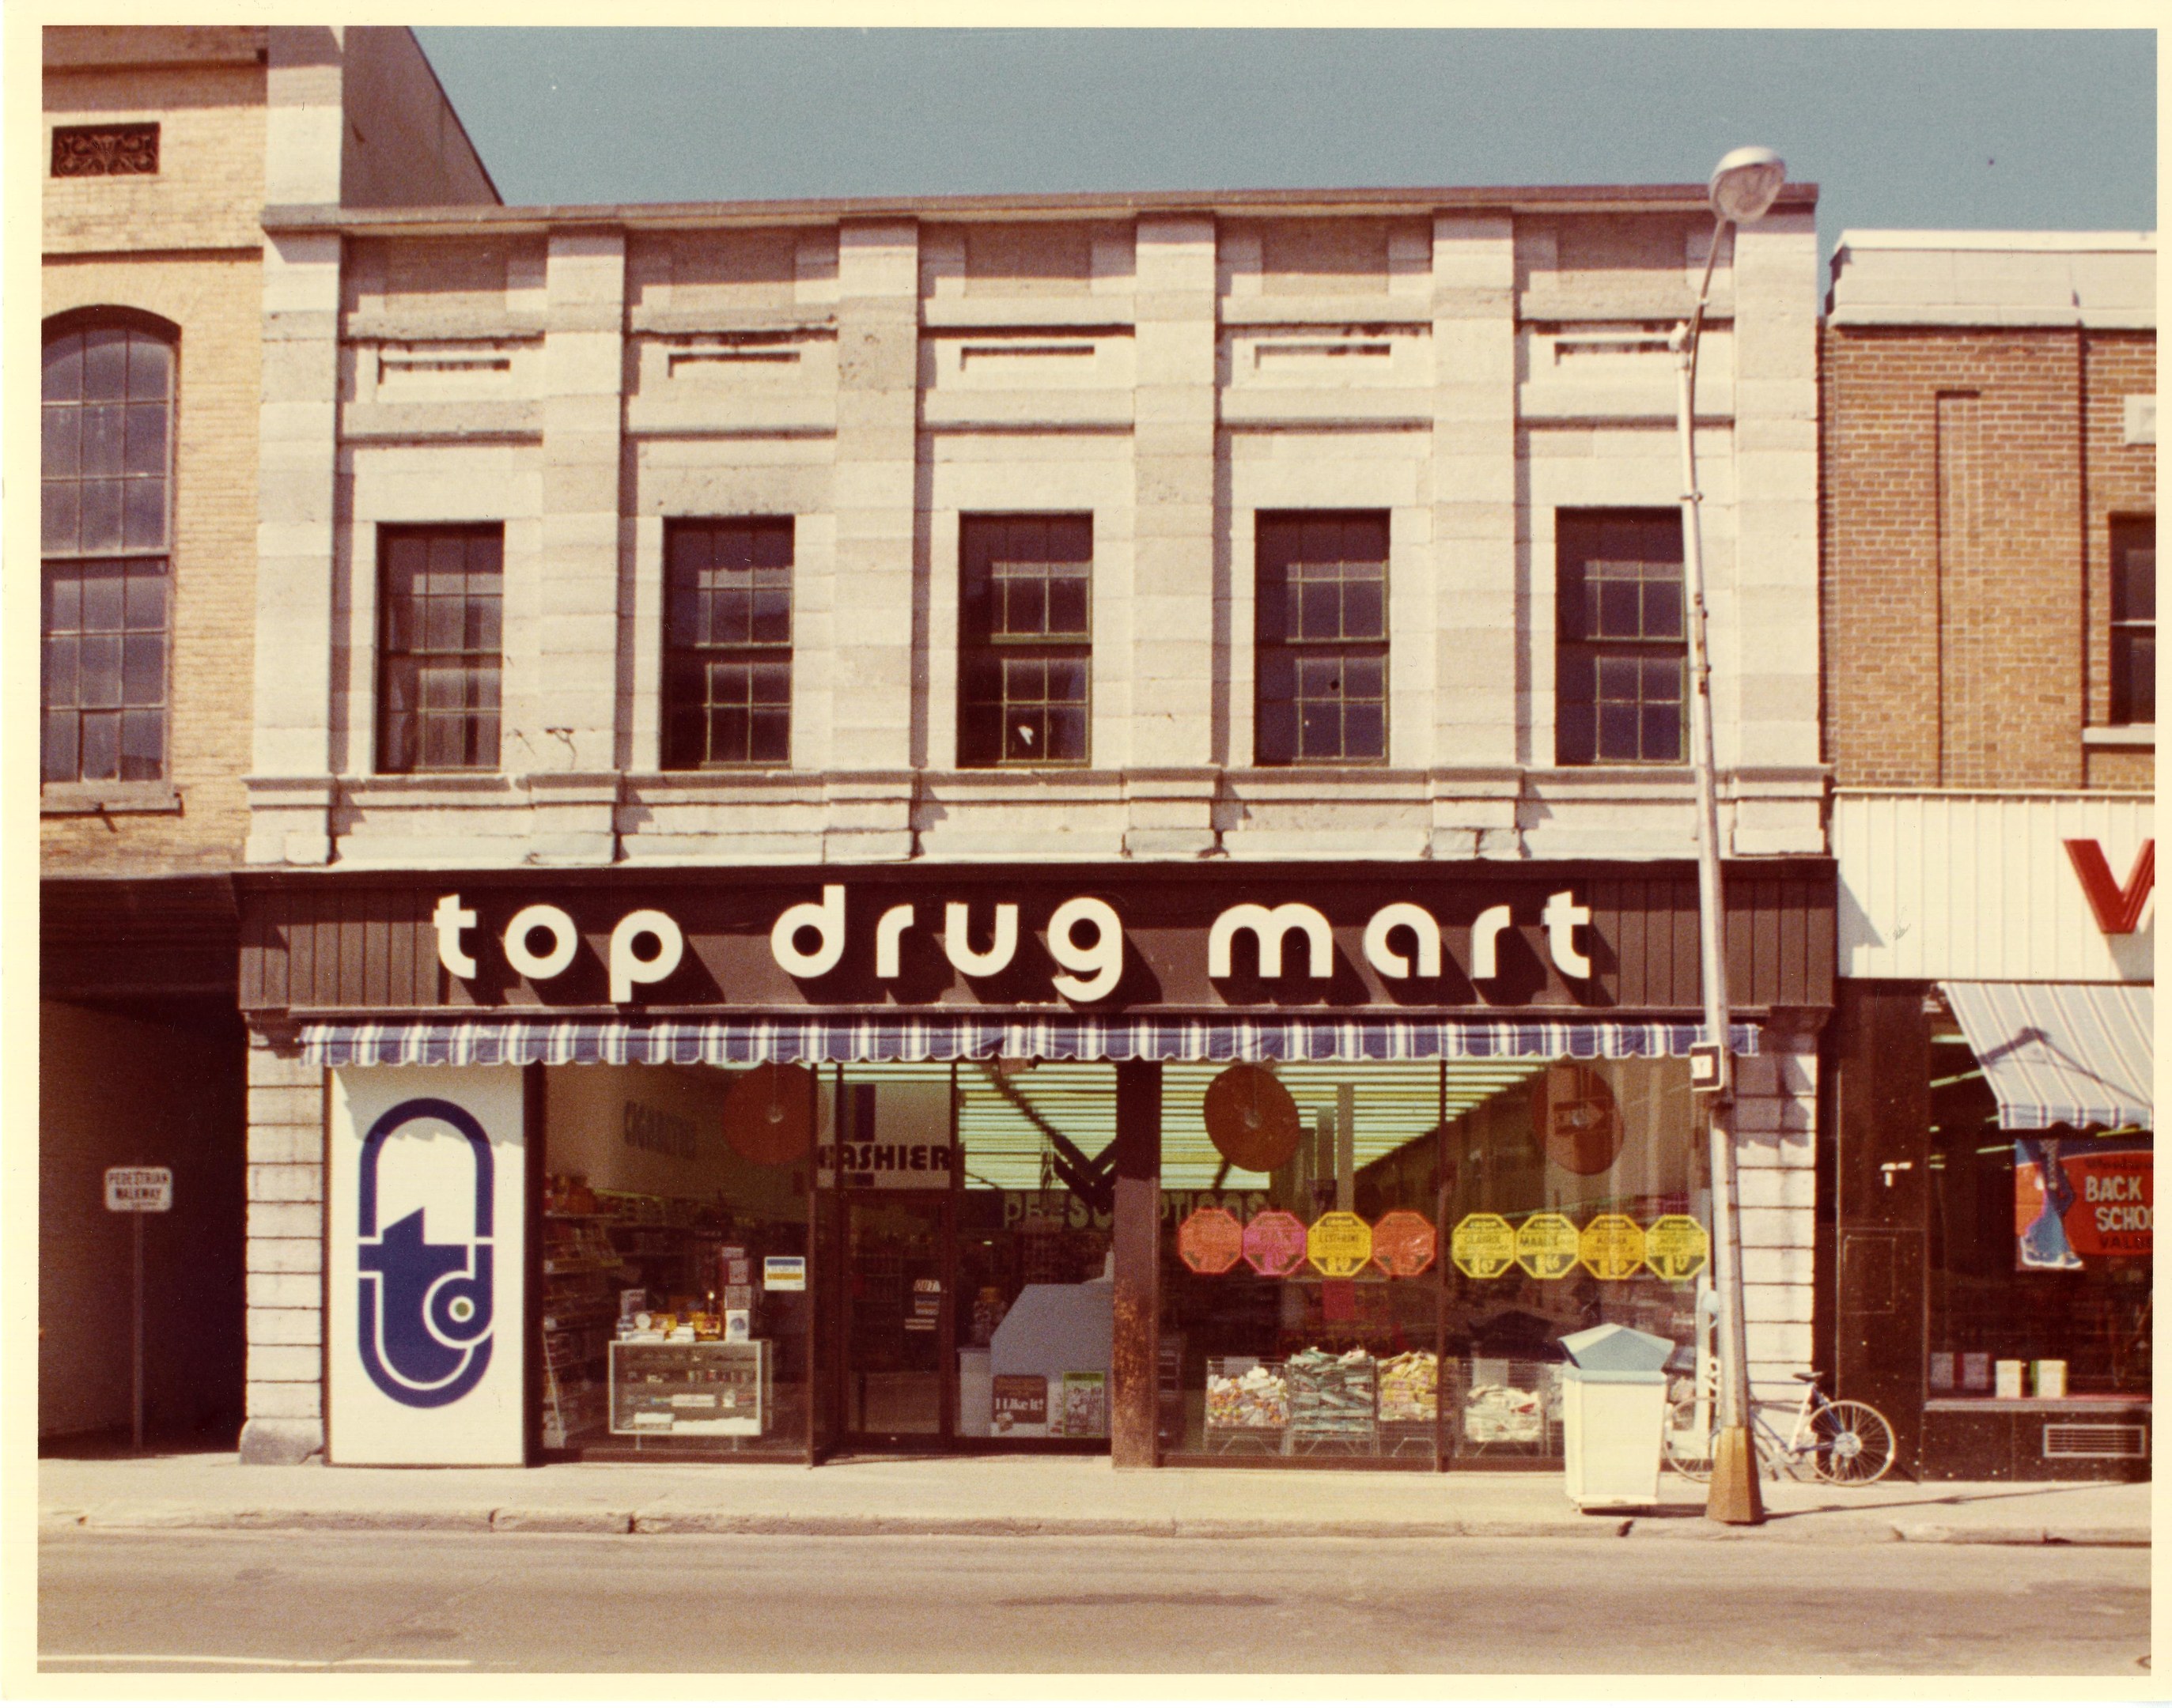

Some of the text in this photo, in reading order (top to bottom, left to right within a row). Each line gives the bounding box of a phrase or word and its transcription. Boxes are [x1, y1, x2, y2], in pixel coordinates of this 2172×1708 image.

[433, 884, 1591, 1003] top drug mart
[2085, 1175, 2142, 1202] BACK
